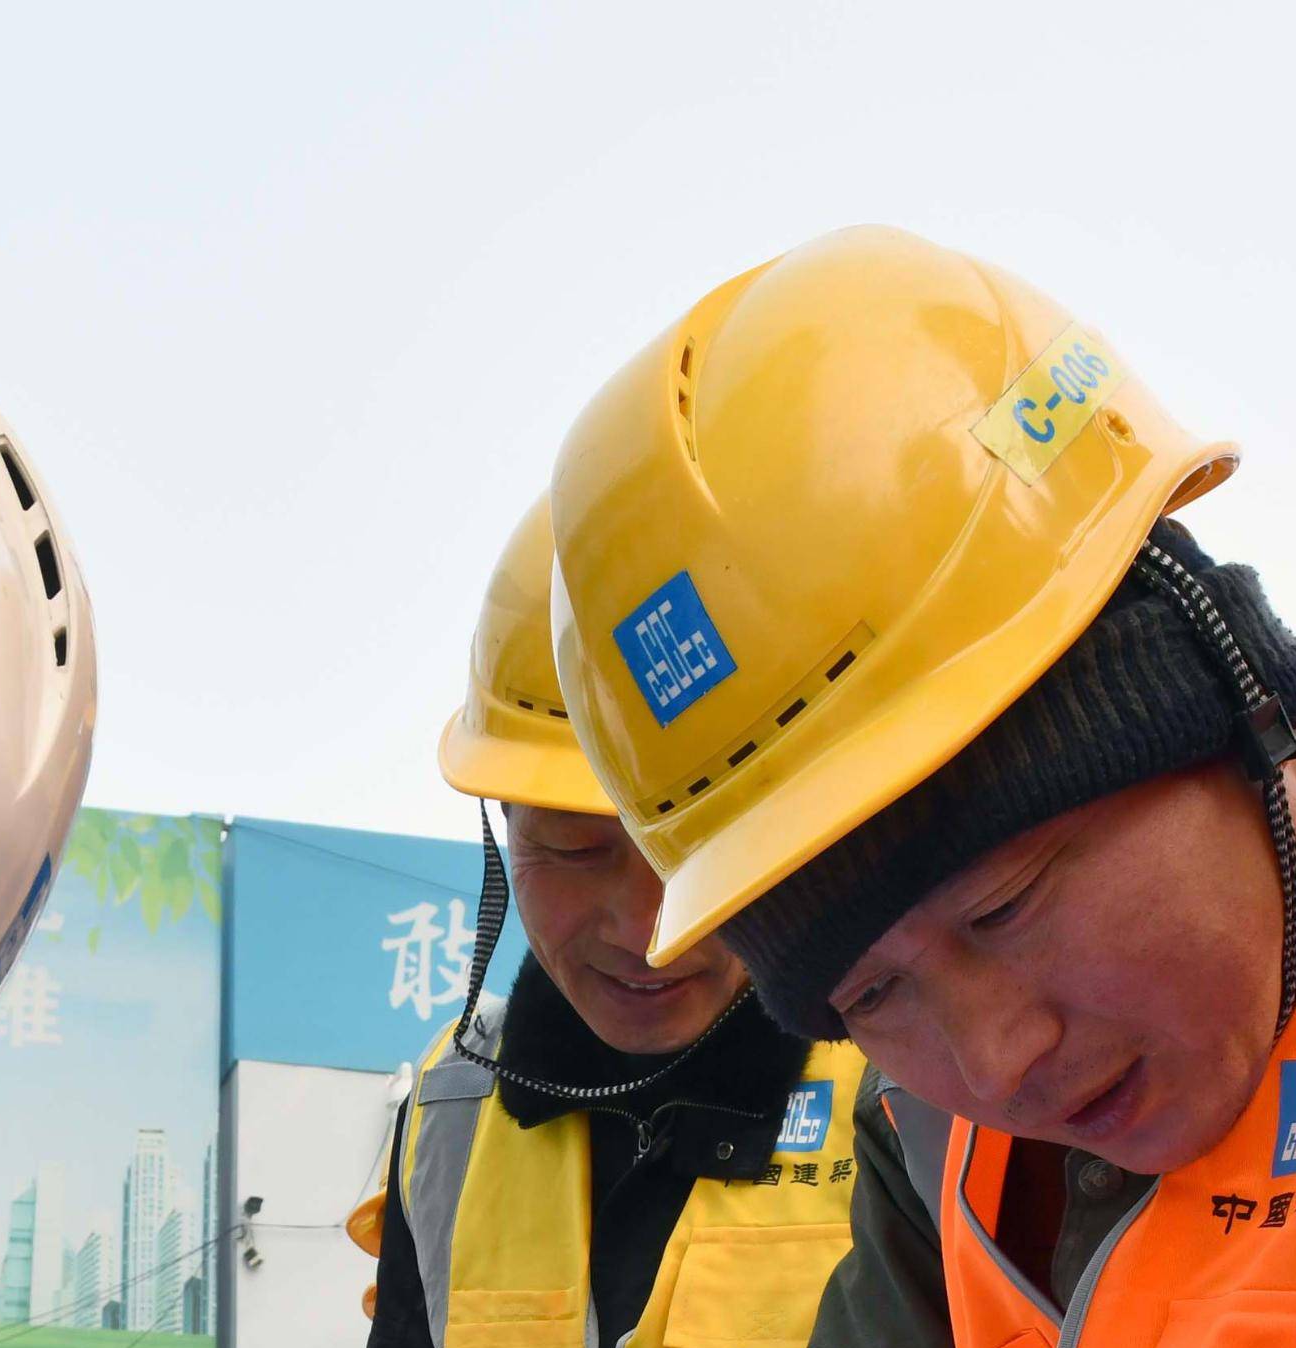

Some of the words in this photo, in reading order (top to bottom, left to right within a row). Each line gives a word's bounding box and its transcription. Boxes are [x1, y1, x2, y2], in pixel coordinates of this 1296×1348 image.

[1013, 342, 1109, 443] C-006
[382, 898, 505, 1021] 敢
[724, 1158, 854, 1188] 國建築
